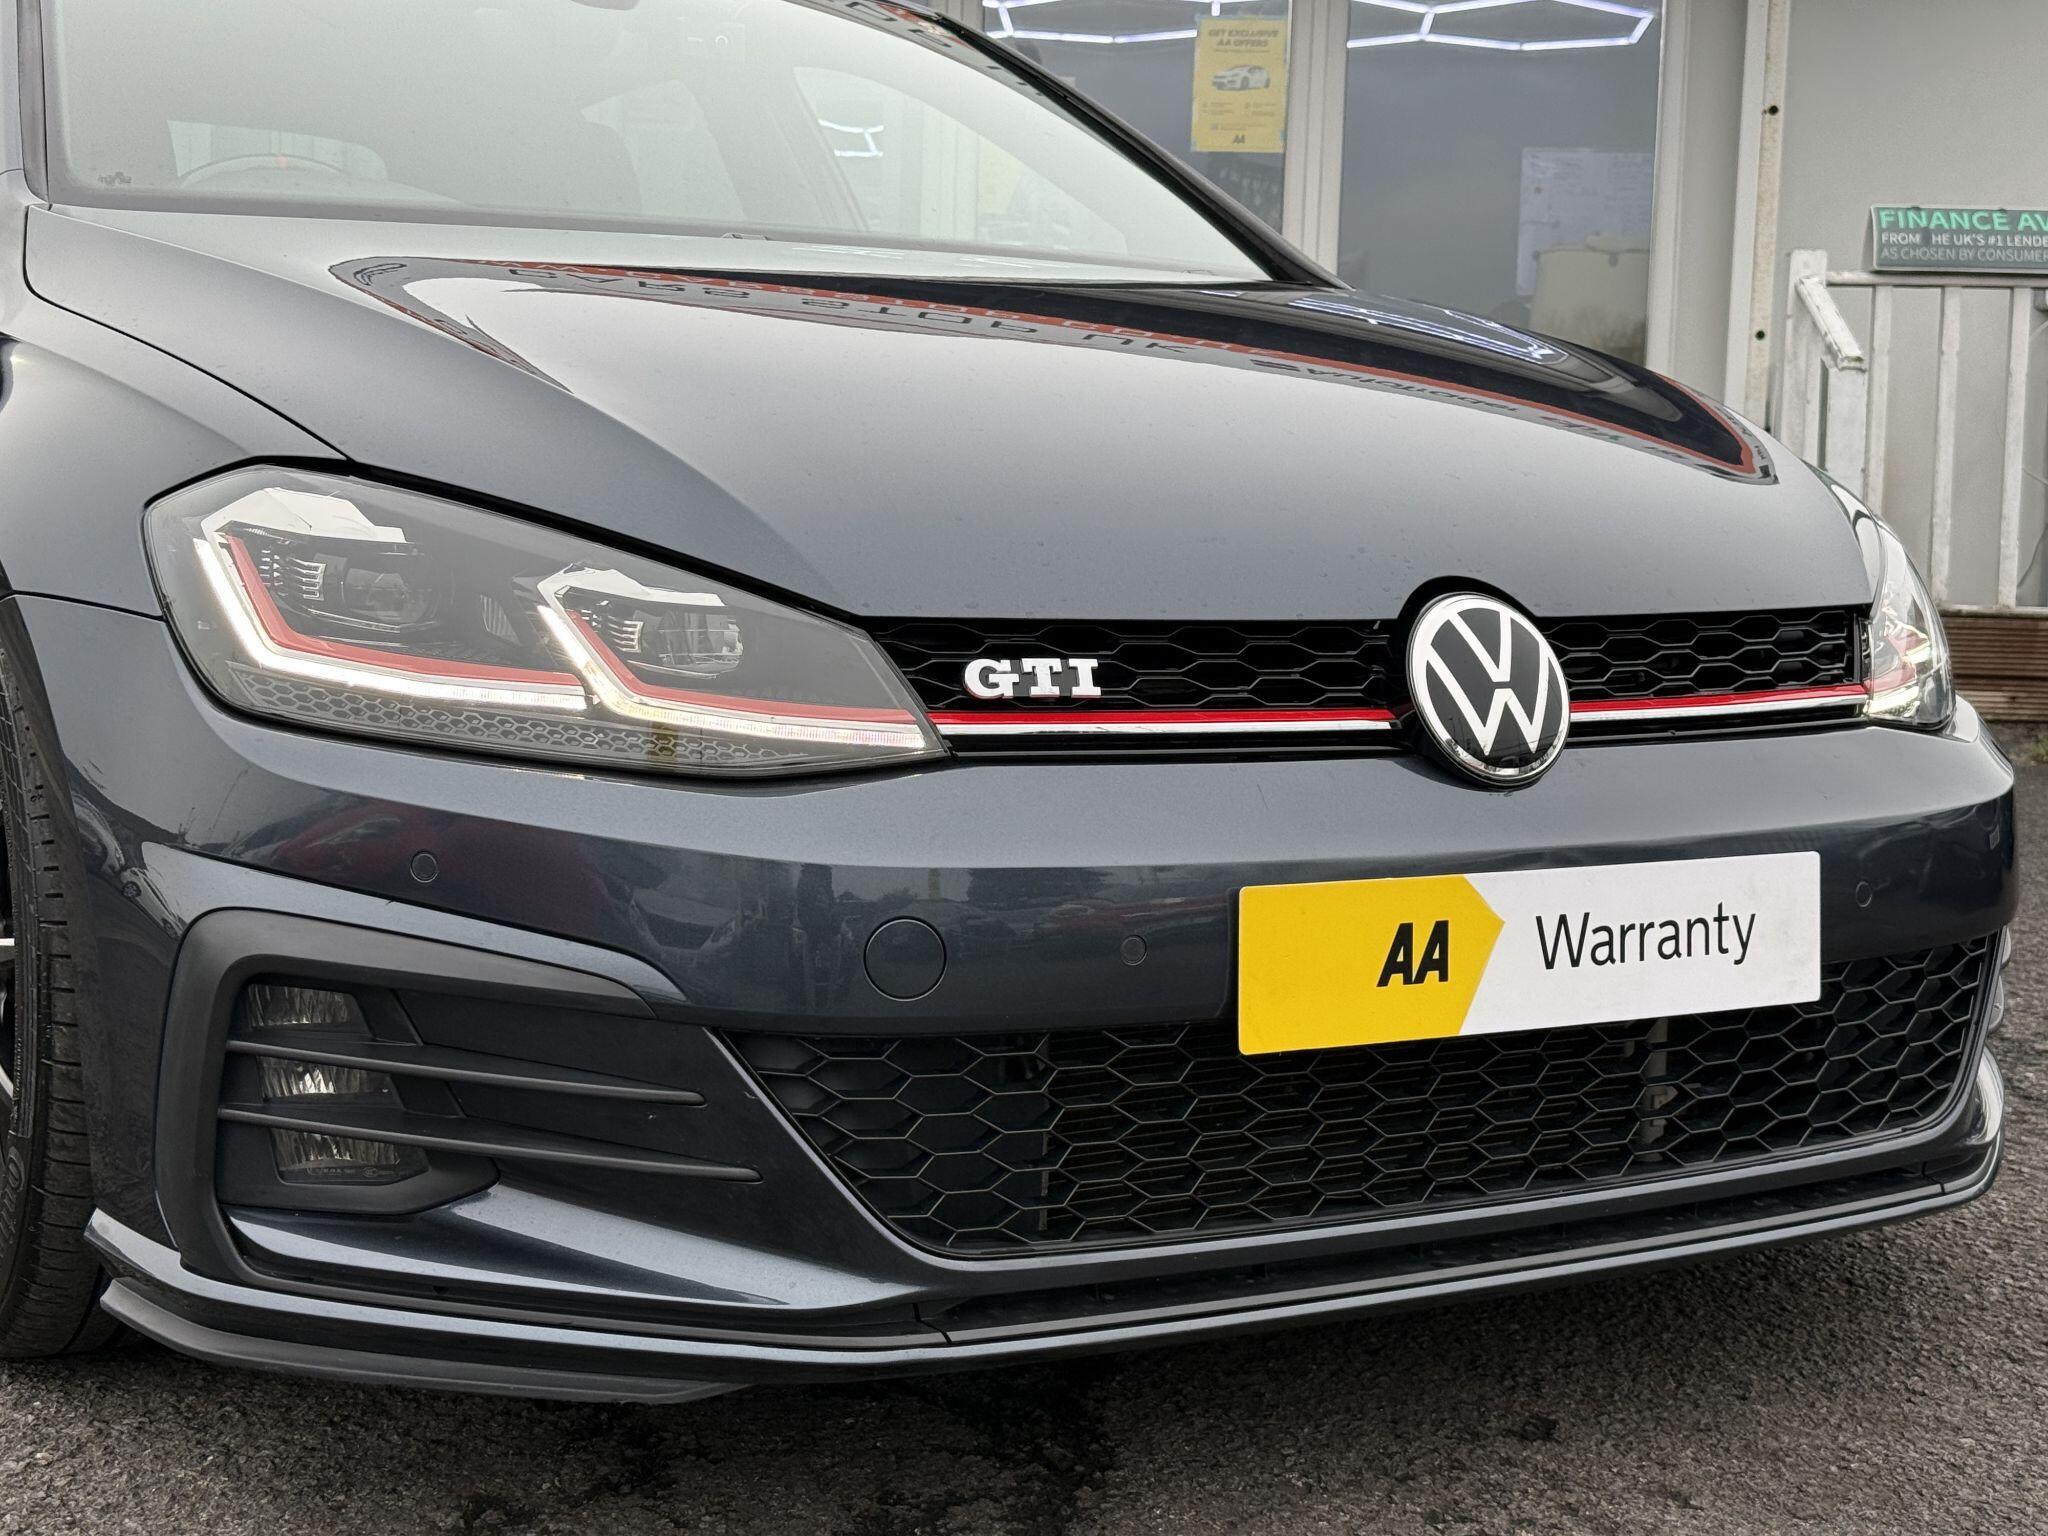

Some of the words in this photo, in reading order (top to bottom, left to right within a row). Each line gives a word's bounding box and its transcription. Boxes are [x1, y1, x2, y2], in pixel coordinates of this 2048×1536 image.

[1208, 29, 1226, 38] GET
[1228, 29, 1280, 38] EXCLUSIVE
[1217, 38, 1232, 47] AA
[1234, 38, 1268, 48] OFFERS
[1879, 208, 2010, 231] FINANCE
[1881, 231, 1921, 245] FROM
[1953, 233, 1985, 246] UK'S
[1988, 234, 2003, 247] #1
[1881, 247, 1898, 260] AS
[1901, 247, 1957, 261] CHOSEN
[1959, 249, 1976, 262] BY
[963, 656, 1102, 700] GTI
[1376, 919, 1449, 988] AA
[1535, 902, 1757, 970] Warranty
